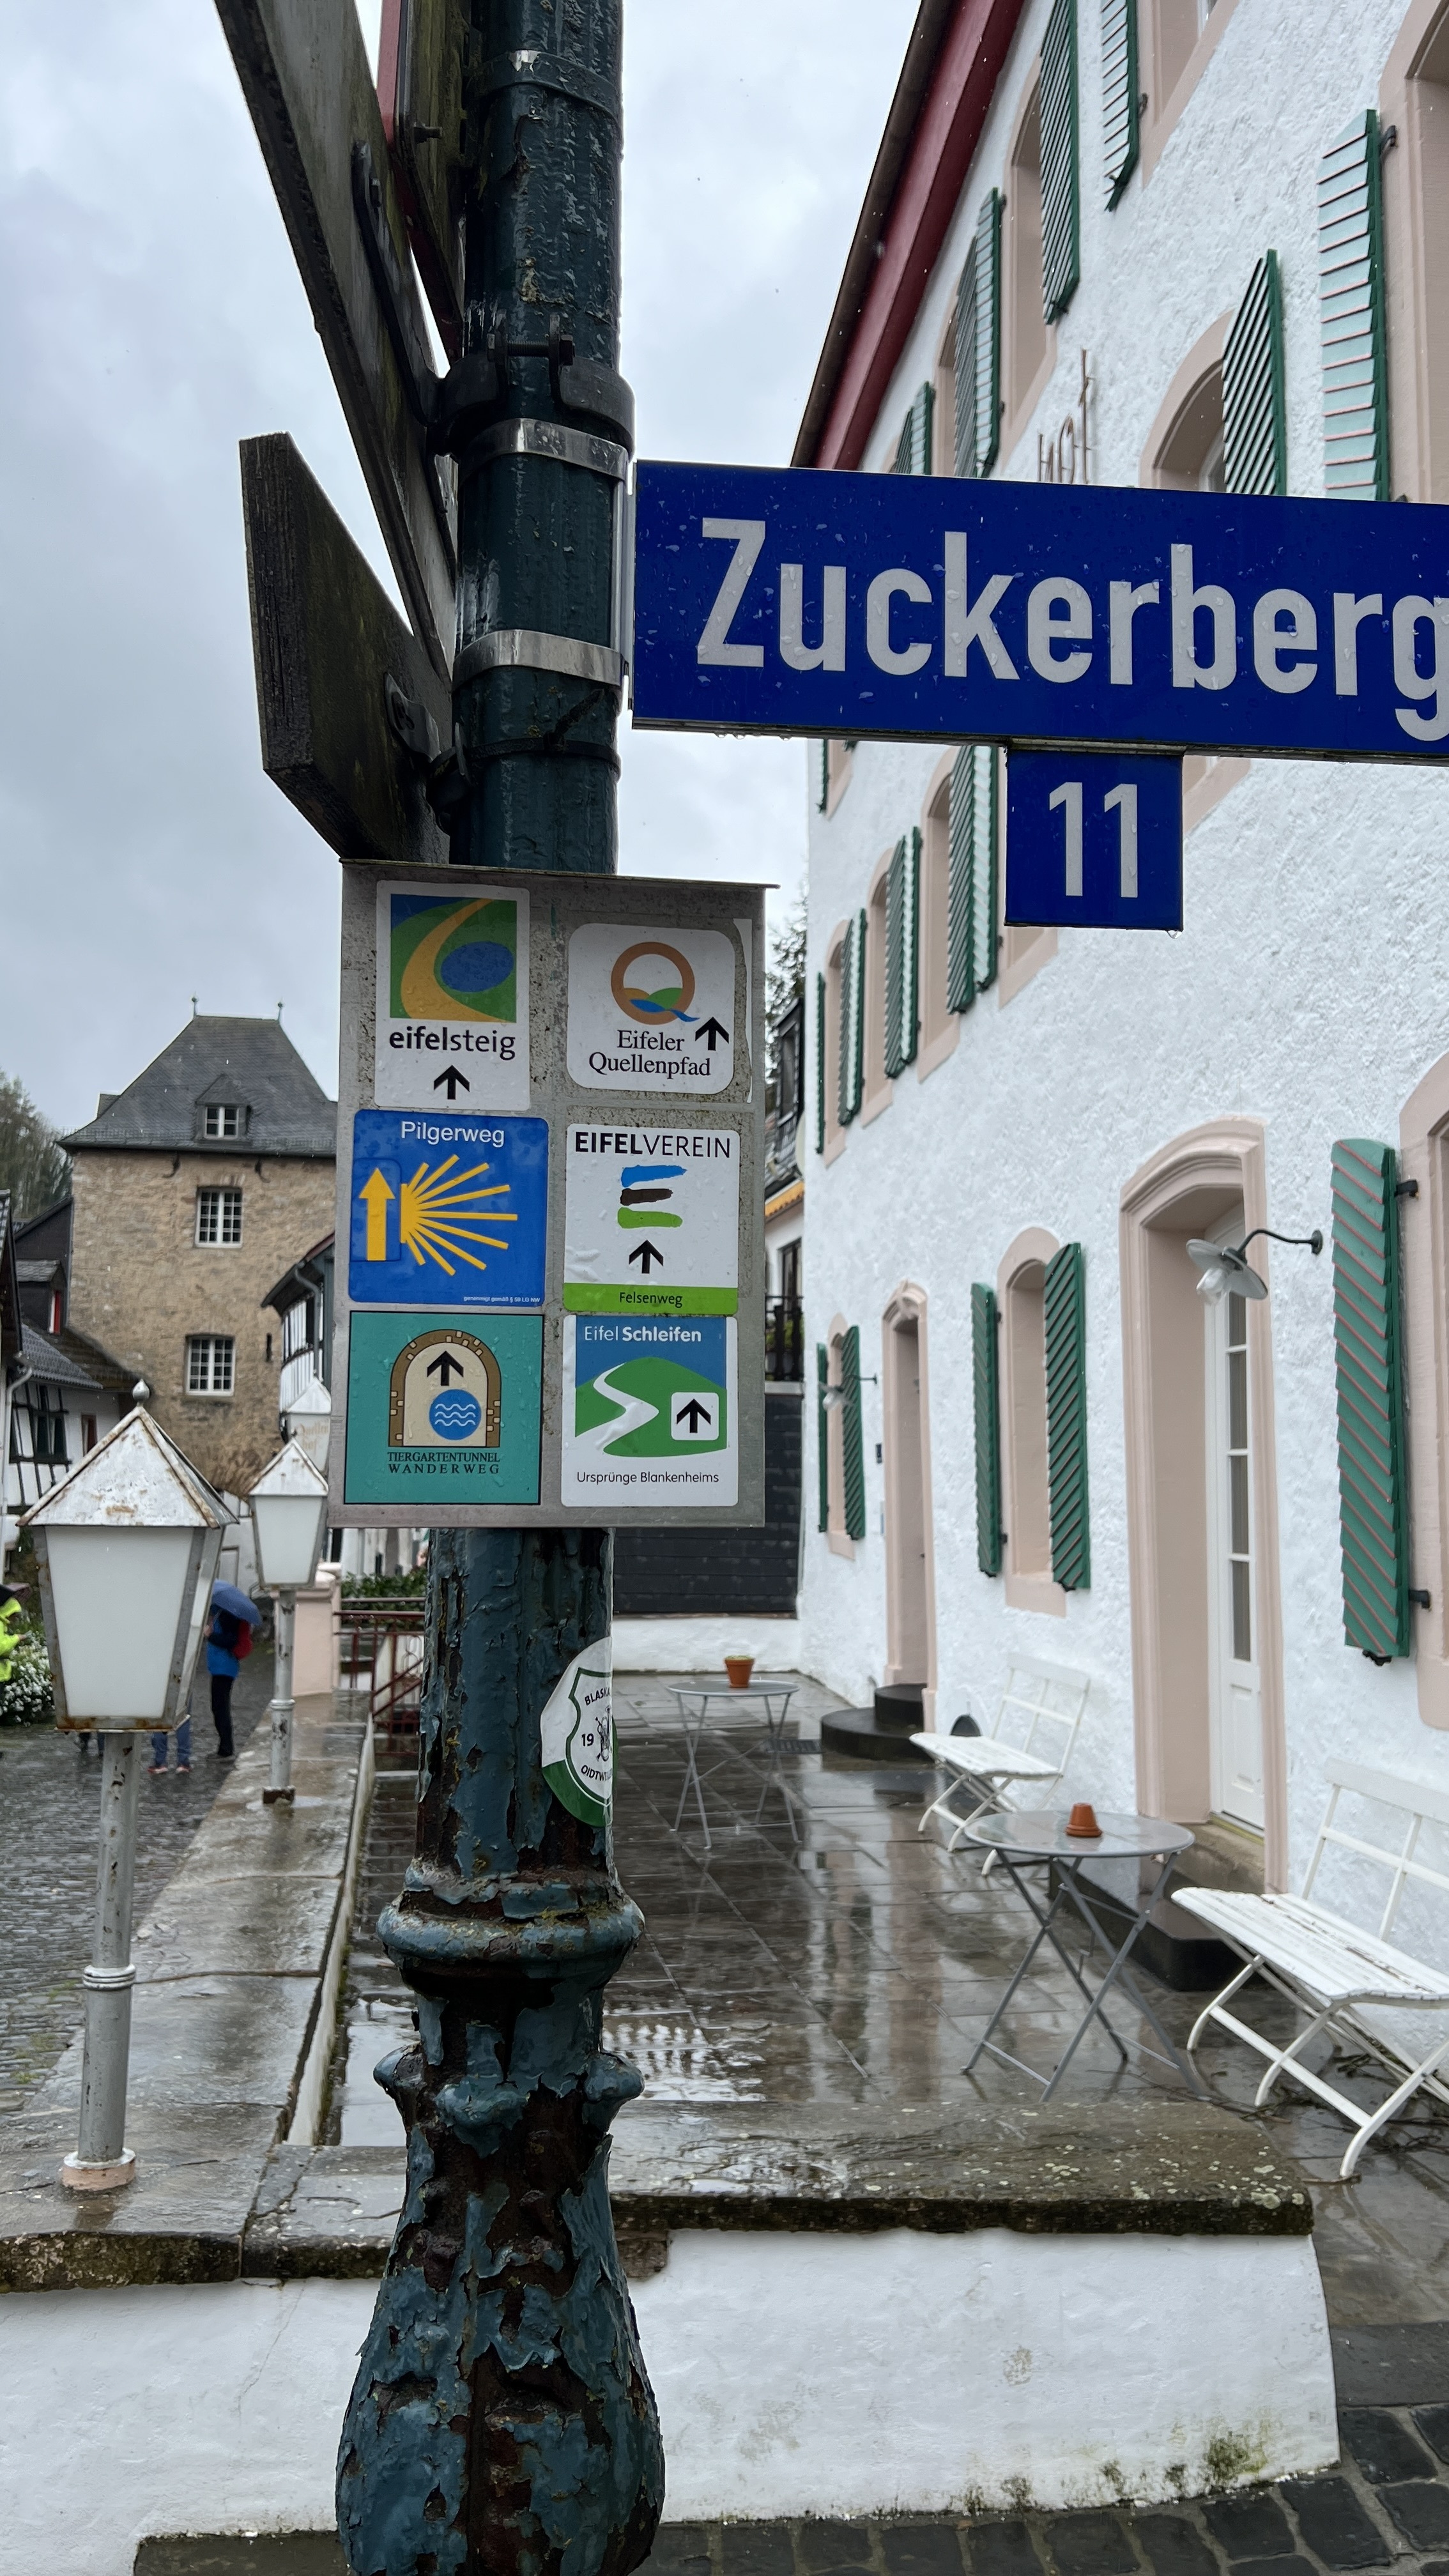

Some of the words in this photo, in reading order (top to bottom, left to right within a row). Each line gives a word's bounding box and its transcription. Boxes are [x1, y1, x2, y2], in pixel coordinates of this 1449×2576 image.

[696, 517, 1449, 742] Zuckerberg
[1049, 781, 1138, 898] 11
[389, 1025, 516, 1061] eifelsteig
[617, 1029, 685, 1052] Eifeler
[588, 1051, 712, 1077] Quellenpfad
[401, 1121, 505, 1148] Pilgerweg
[575, 1131, 731, 1158] EIFELVEREIN
[619, 1291, 683, 1308] Felsenweg
[584, 1325, 618, 1342] Eifel
[622, 1326, 702, 1342] Schleifen
[387, 1452, 501, 1462] TIERGARTENTUNNEL
[388, 1463, 500, 1475] WANDERWEG
[577, 1471, 637, 1485] Ursprünge
[640, 1471, 719, 1483] Blankenheims
[581, 1733, 594, 1747] 19
